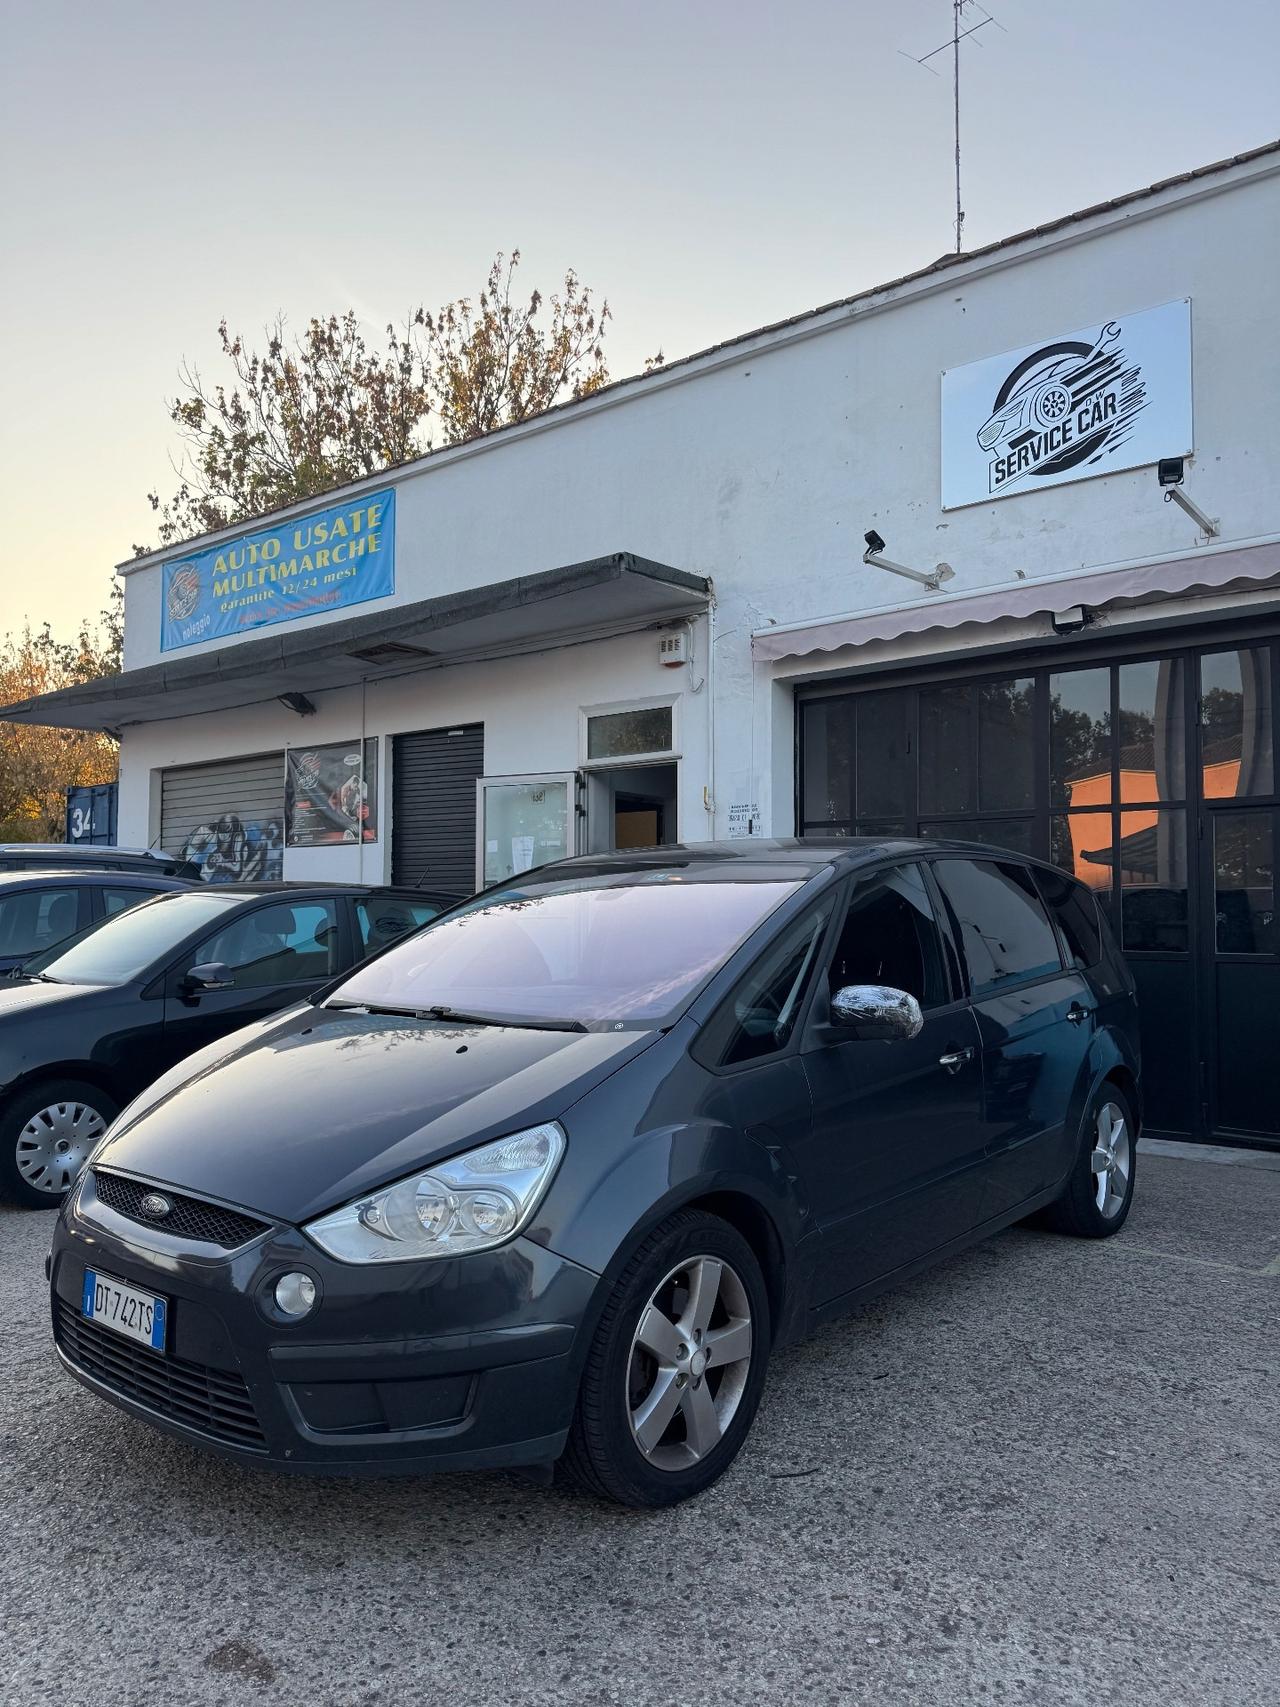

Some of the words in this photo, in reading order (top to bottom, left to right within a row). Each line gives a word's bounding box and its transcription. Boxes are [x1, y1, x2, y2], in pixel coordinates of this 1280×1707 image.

[995, 418, 1073, 485] SERVICE
[1077, 392, 1118, 435] CAR
[212, 538, 281, 577] AUTO
[293, 503, 383, 550] USATE
[212, 532, 382, 598] MULTIMARCHE
[324, 566, 357, 584] mesi
[182, 613, 211, 641] noleggio
[71, 807, 96, 838] 34
